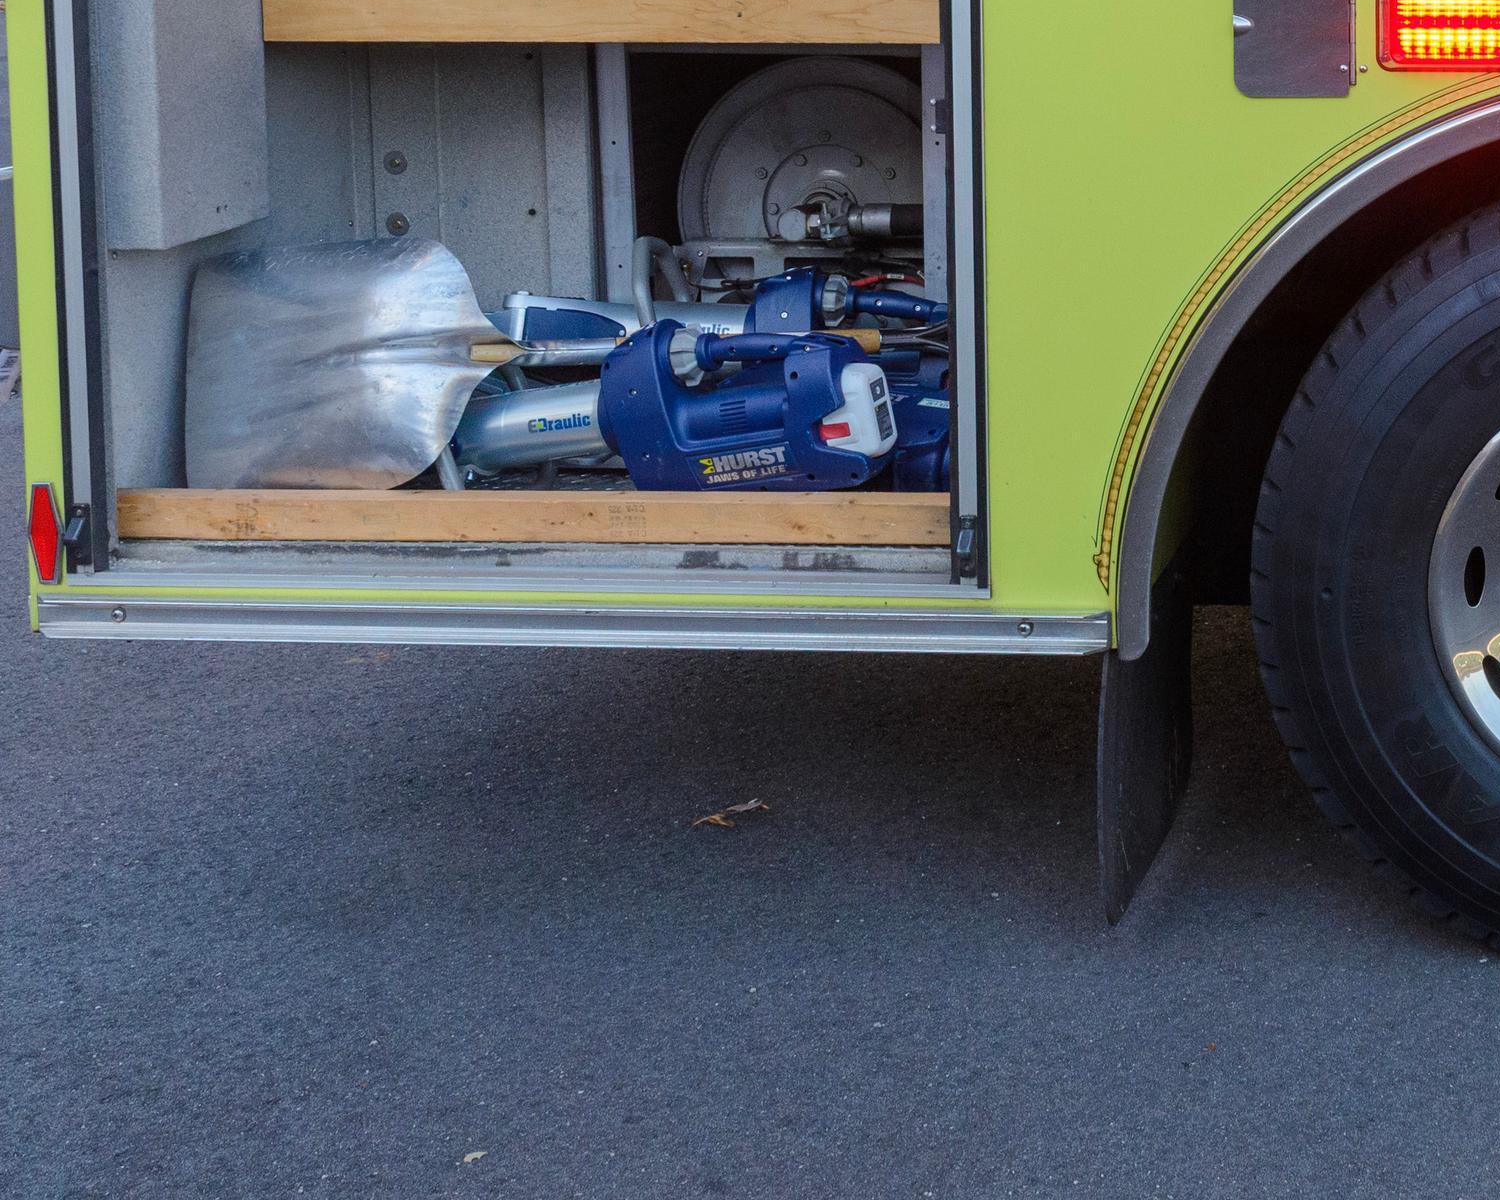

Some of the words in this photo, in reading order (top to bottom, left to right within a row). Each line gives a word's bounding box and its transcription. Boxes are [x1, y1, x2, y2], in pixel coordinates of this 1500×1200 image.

[712, 446, 785, 473] HURST
[706, 471, 740, 484] JAWS
[742, 469, 758, 479] OF
[760, 464, 787, 476] LIFE
